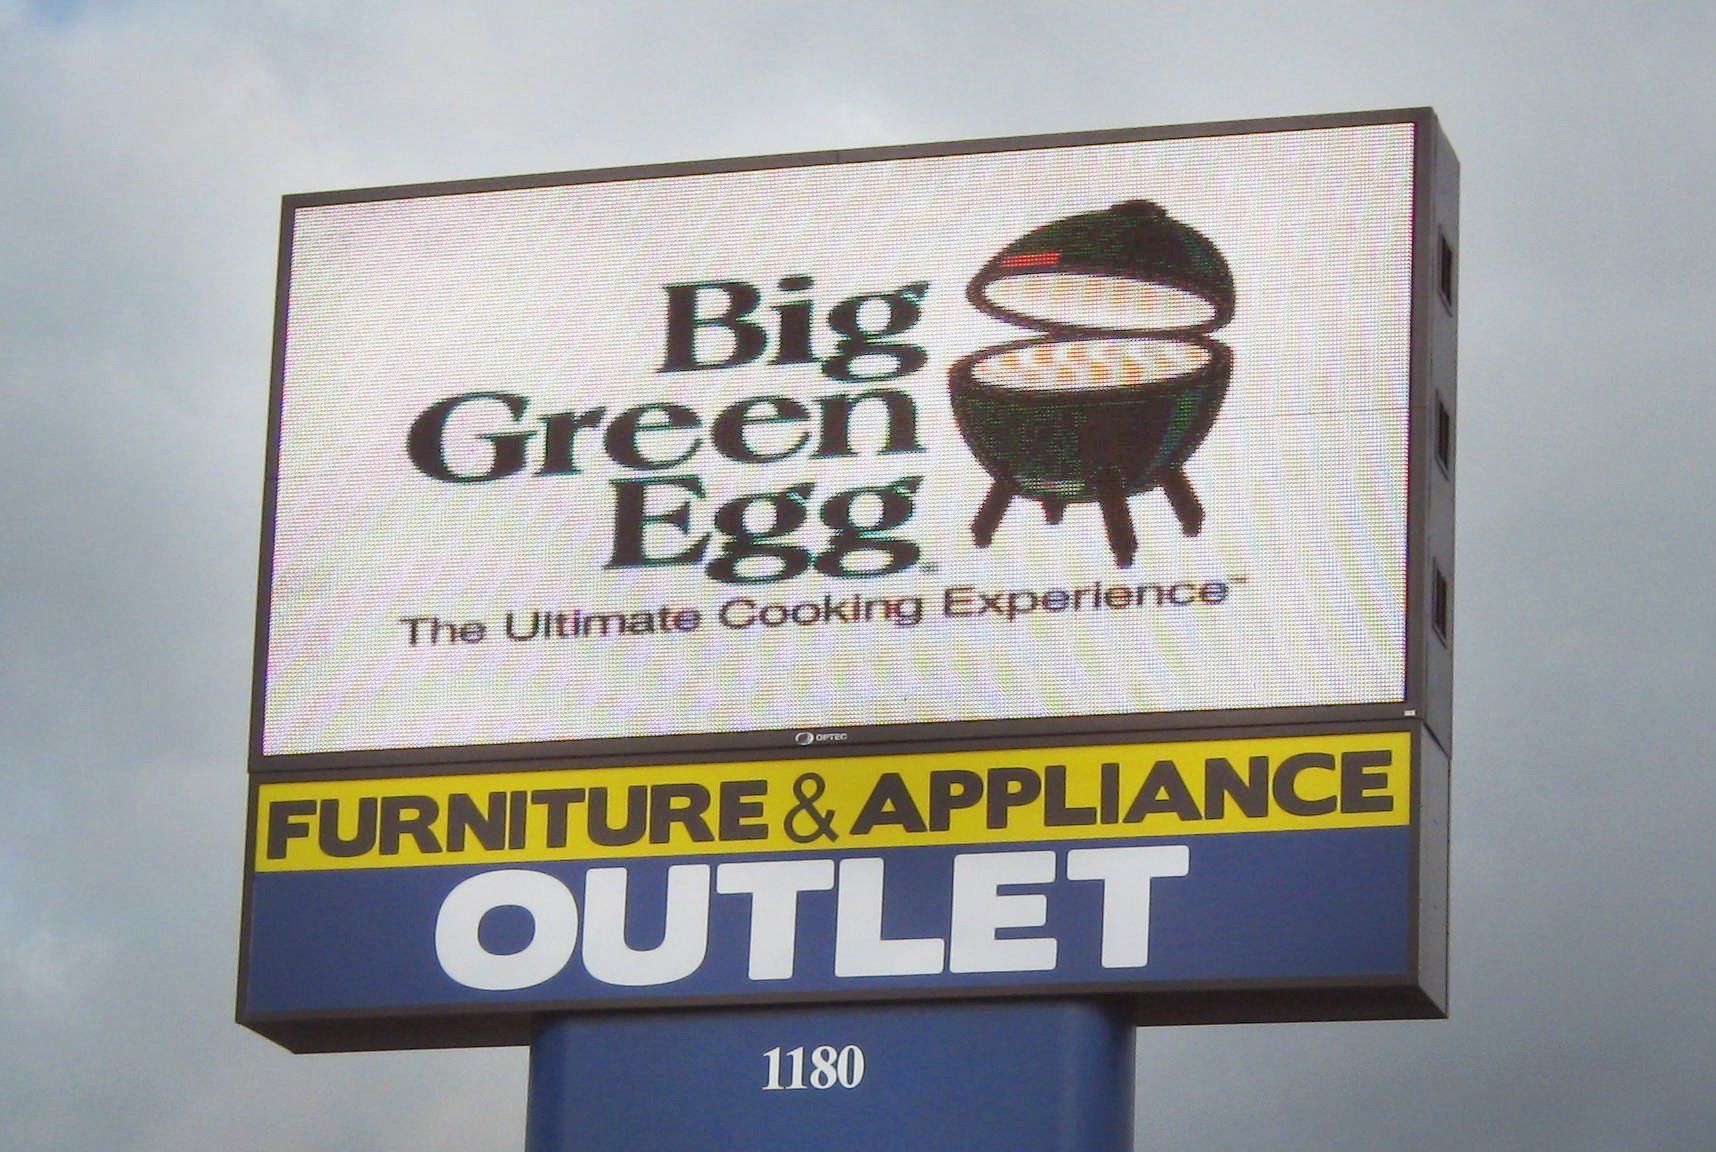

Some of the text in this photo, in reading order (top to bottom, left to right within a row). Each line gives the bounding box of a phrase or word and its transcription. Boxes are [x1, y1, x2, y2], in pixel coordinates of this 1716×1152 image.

[656, 274, 929, 384] Big
[406, 388, 927, 484] Green
[603, 474, 926, 585] Egg
[400, 580, 1229, 646] The Ultimate Cooking Experience
[265, 749, 1395, 861] FURNITURE & APPLIANCE
[433, 845, 1191, 992] OUTLET
[761, 1044, 865, 1092] 1180
